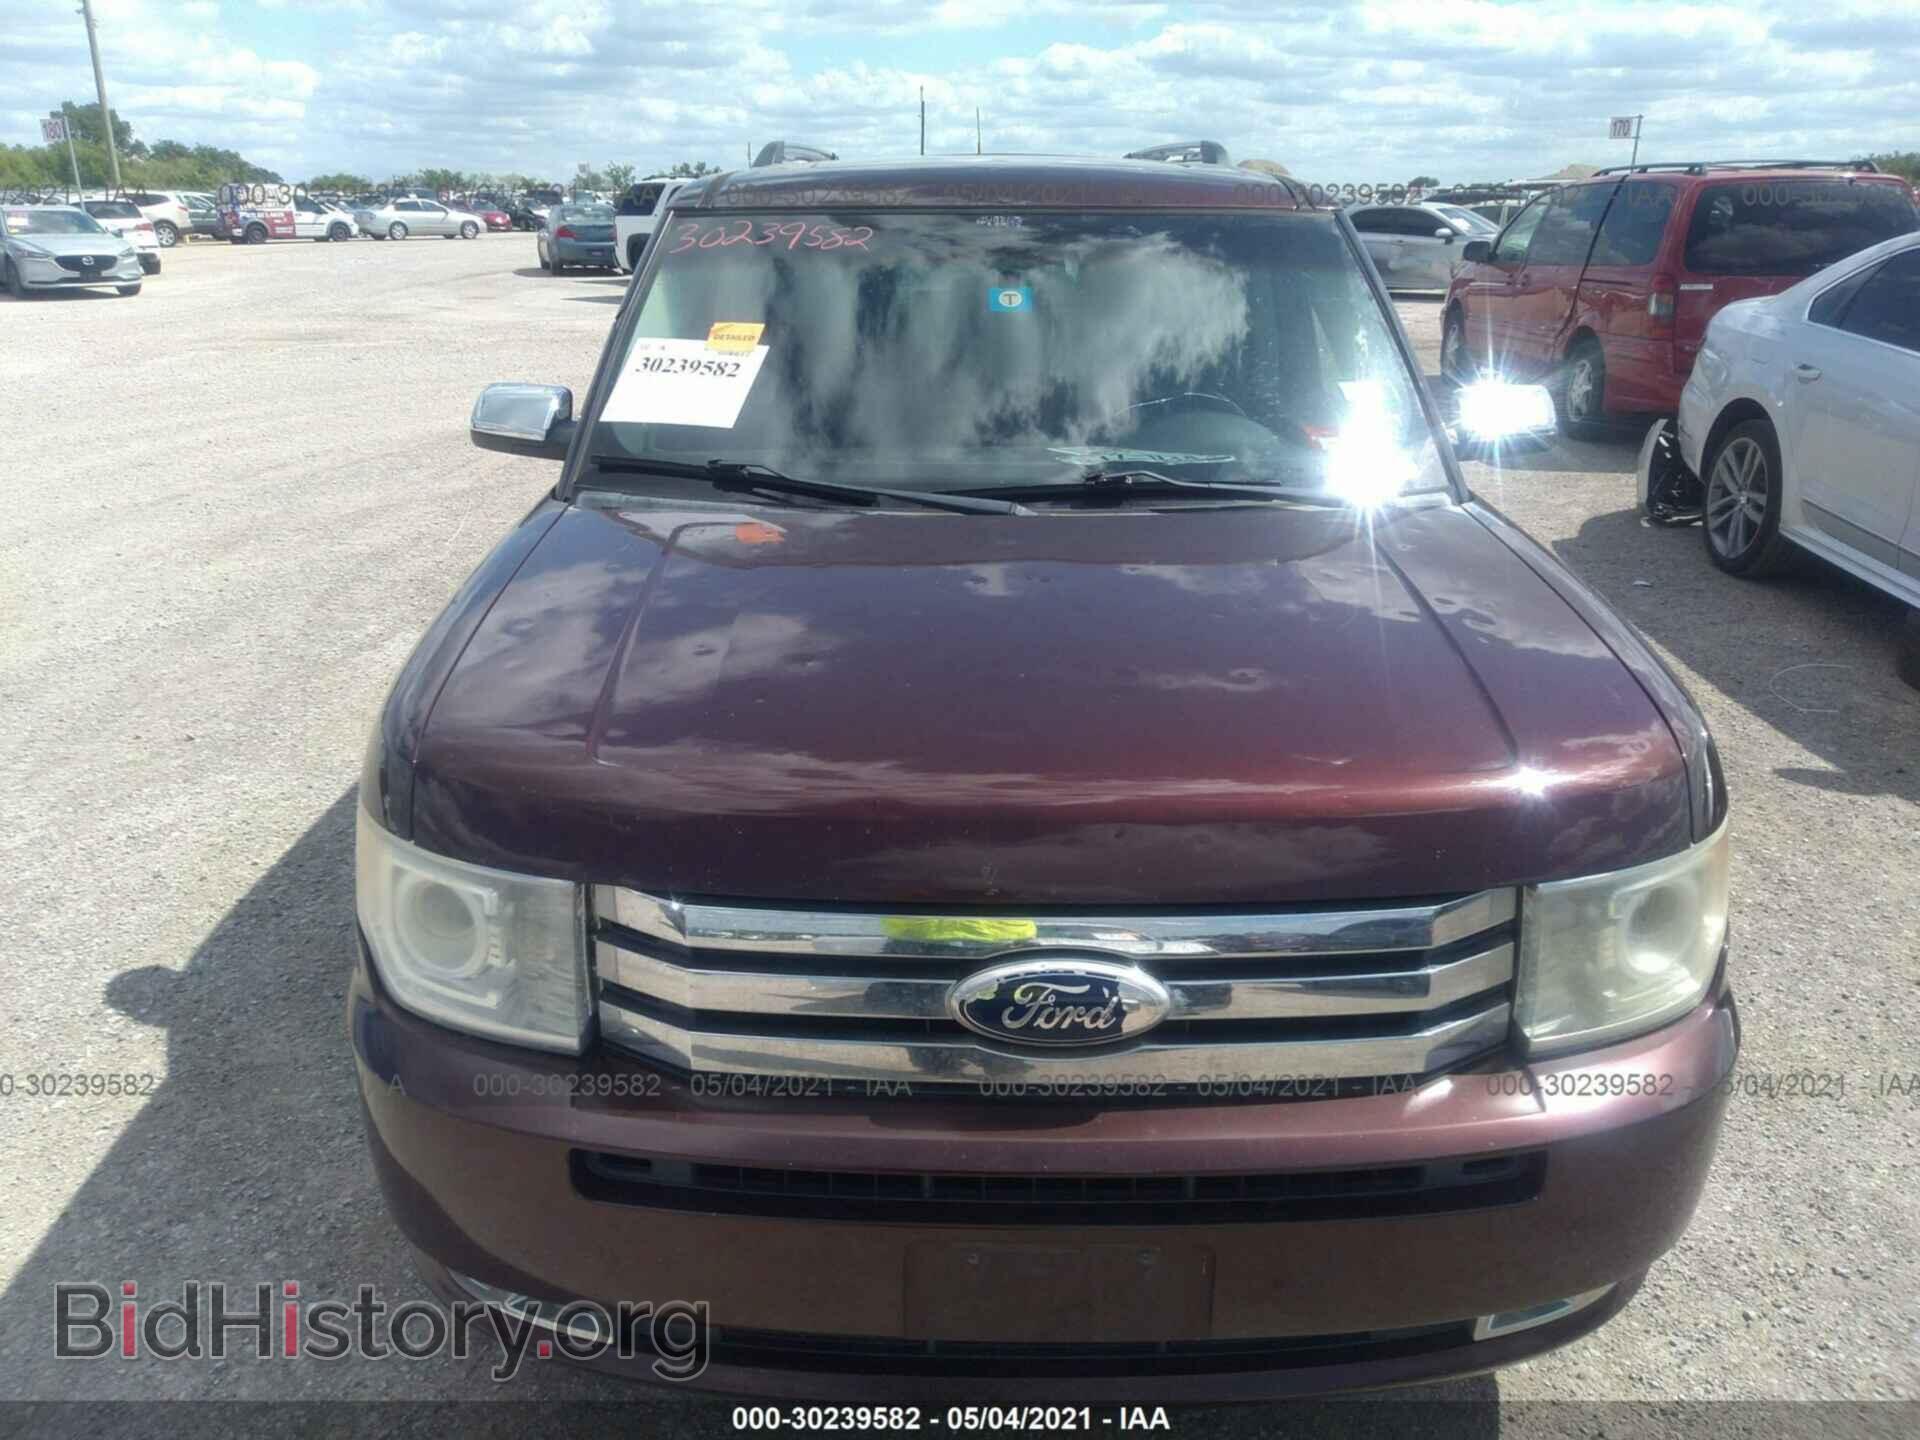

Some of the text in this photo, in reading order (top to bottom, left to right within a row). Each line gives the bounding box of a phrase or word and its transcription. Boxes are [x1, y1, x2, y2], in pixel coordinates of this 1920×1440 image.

[669, 220, 873, 254] 30239582
[635, 356, 741, 378] 30239582
[1002, 982, 1116, 1030] Ford
